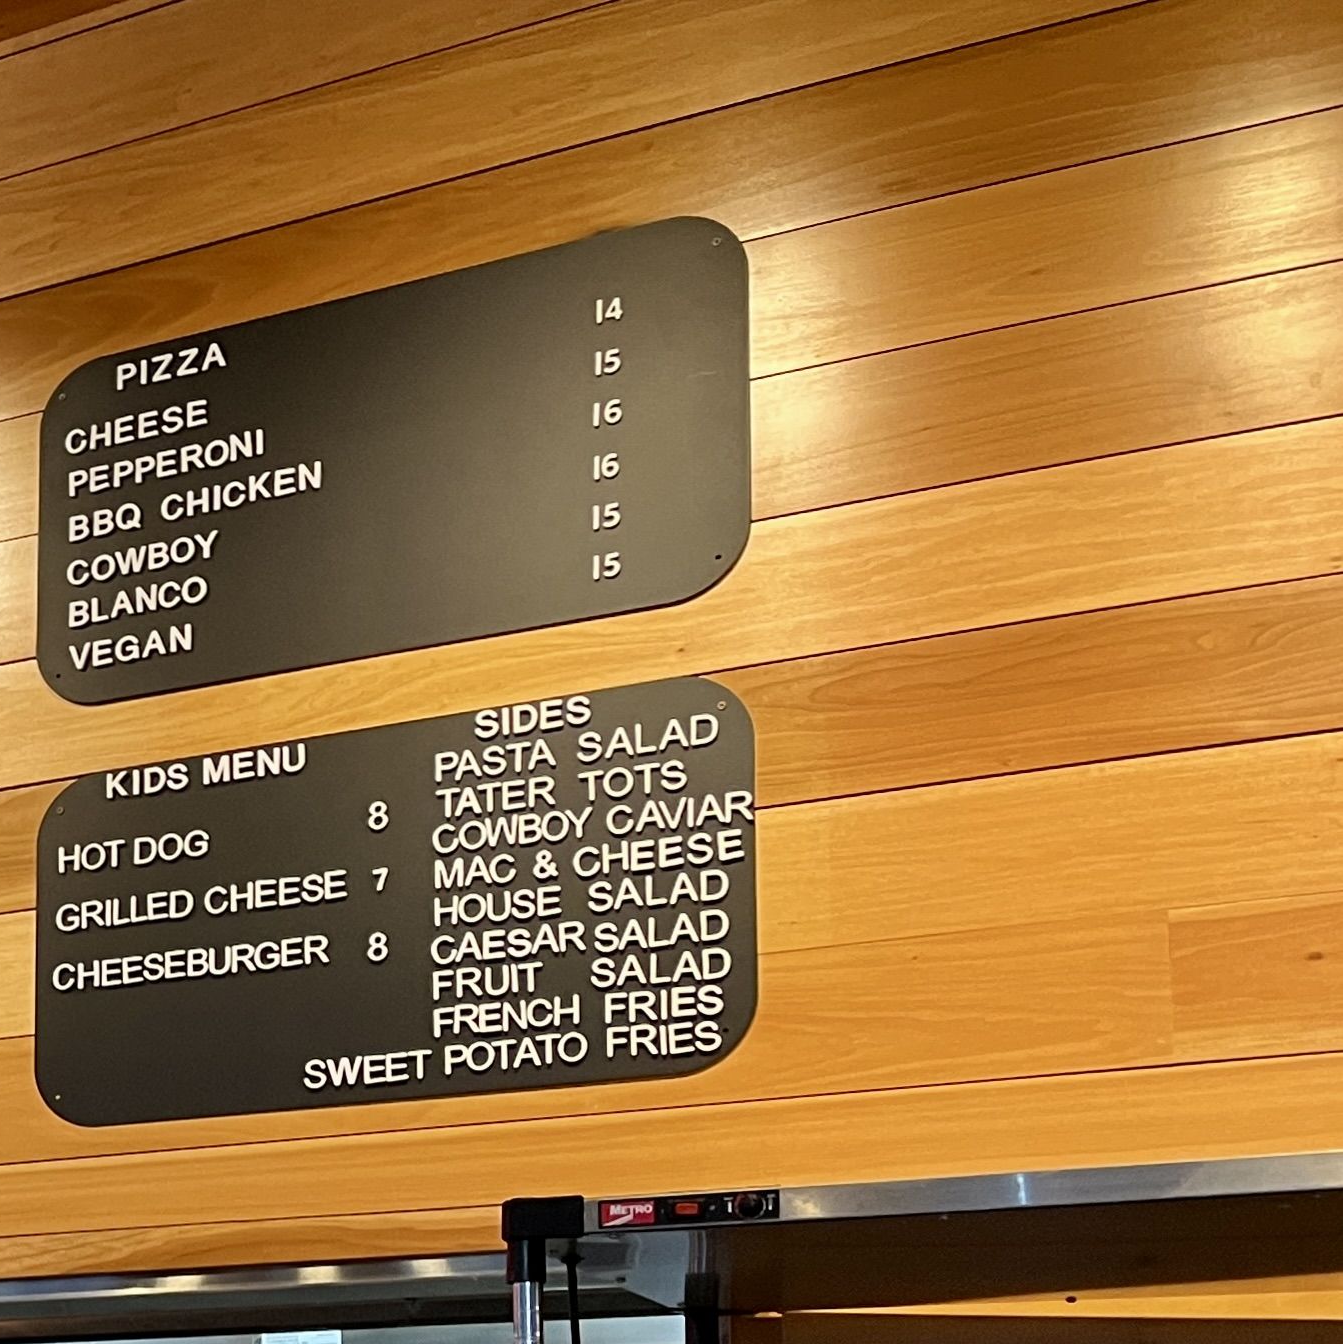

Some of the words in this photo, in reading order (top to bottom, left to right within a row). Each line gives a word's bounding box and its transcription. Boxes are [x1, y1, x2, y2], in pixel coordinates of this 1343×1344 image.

[65, 399, 208, 454] CHEESE
[596, 297, 623, 324] 14
[116, 343, 227, 391] PIZZA
[68, 428, 264, 497] PEPPERONI
[594, 348, 621, 376] 15
[68, 503, 141, 542] BBQ
[160, 460, 322, 521] CHICKEN
[592, 398, 623, 427] 16
[66, 529, 218, 585] COWBOY
[593, 453, 620, 480] 16
[68, 577, 207, 628] BLANCO
[592, 502, 621, 530] 15
[68, 623, 192, 670] VEGAN
[592, 552, 621, 580] 15
[434, 739, 557, 782] PASTA
[576, 713, 719, 762] SALAD
[474, 695, 592, 739] SIDES
[106, 763, 189, 799] KIDS
[202, 742, 306, 785] MENU
[435, 775, 555, 818] TATER
[577, 760, 688, 798] TOTS
[58, 839, 126, 874] HOT
[133, 829, 210, 865] DOG
[367, 801, 389, 831] 8
[431, 806, 593, 854] COWBOY
[605, 790, 753, 835] CAVIAR
[434, 854, 517, 889] MAC
[532, 850, 559, 879] &
[572, 828, 745, 877] CHEESE
[55, 889, 194, 932] GRILLED
[204, 869, 348, 915] CHEESE
[372, 867, 389, 891] 7
[433, 885, 563, 927] HOUSE
[587, 869, 729, 912] SALAD
[52, 934, 330, 991] CHEESEBURGER
[366, 932, 389, 962] 8
[430, 920, 587, 965] CAESAR
[594, 909, 730, 953] SALAD
[432, 961, 544, 1001] FRUIT
[590, 947, 732, 988] SALAD
[432, 994, 580, 1038] FRENCH
[604, 984, 724, 1024] FRIES
[303, 1049, 433, 1089] SWEET
[444, 1031, 588, 1075] POTATO
[606, 1021, 722, 1058] FRIES
